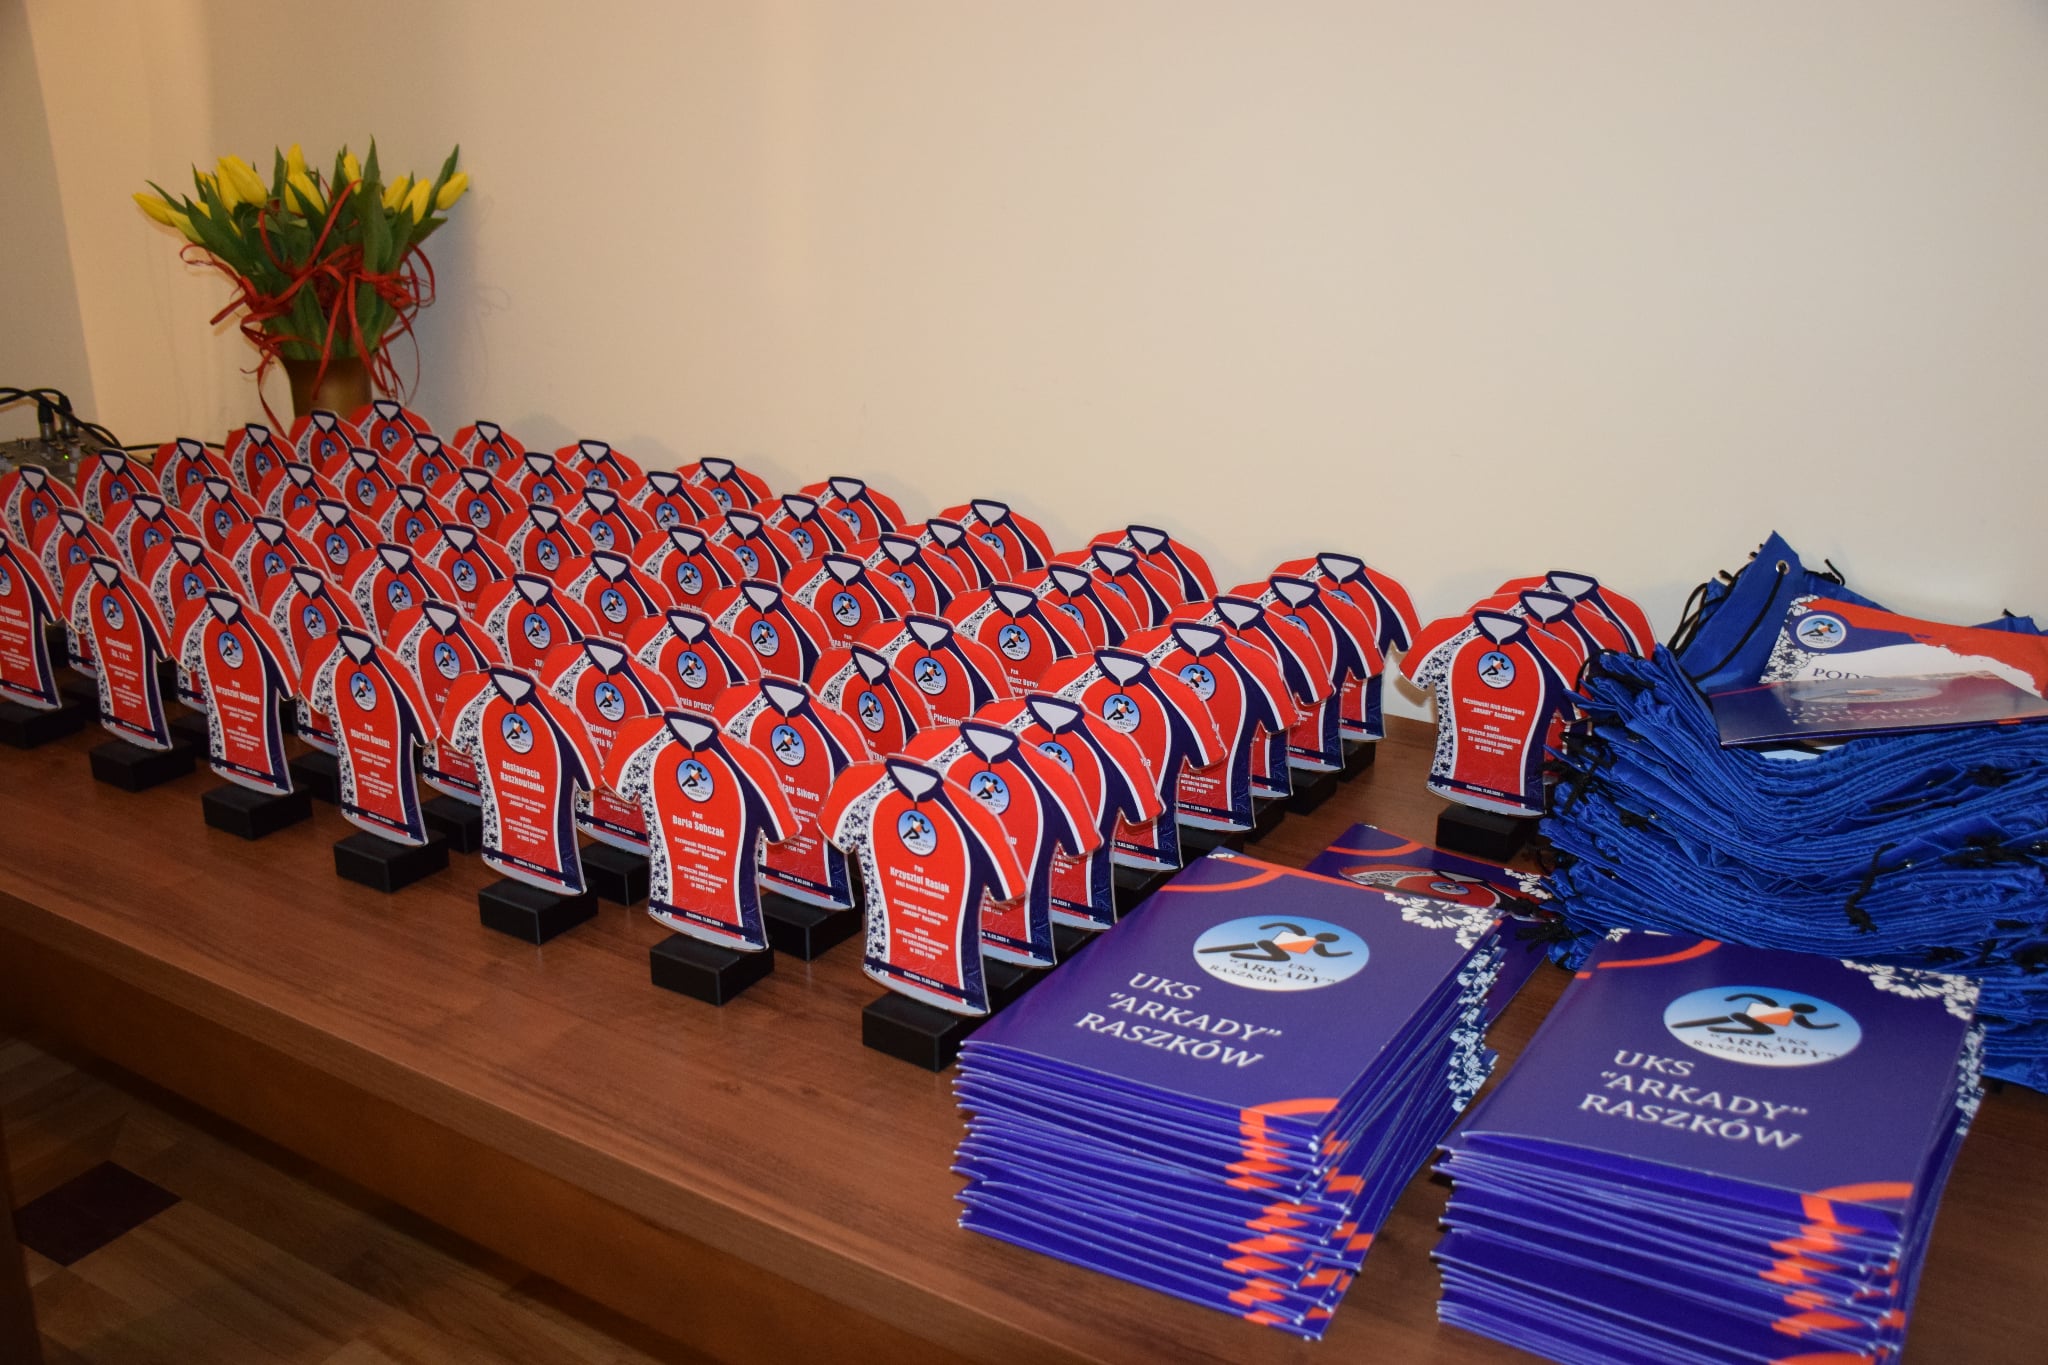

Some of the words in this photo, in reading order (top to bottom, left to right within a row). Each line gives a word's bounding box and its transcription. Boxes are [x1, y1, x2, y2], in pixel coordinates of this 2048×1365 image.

[502, 760, 540, 779] Restauracja
[796, 787, 820, 802] Sikora
[692, 811, 703, 820] Pani
[672, 815, 692, 828] Daria
[694, 821, 725, 838] Sobczak
[914, 864, 924, 873] Pan
[890, 866, 923, 885] Krzysztof
[925, 878, 949, 893] Rasiak
[1209, 964, 1283, 984] RASZKÓW
[1288, 963, 1317, 973] UKS
[1129, 971, 1201, 1000] UKS
[1074, 1011, 1265, 1068] RASZKÓW
[1776, 1036, 1810, 1047] UKS
[1692, 1040, 1778, 1059] RASZKÓW
[1612, 1049, 1696, 1077] UKS
[1578, 1092, 1804, 1149] RASZKÓW
